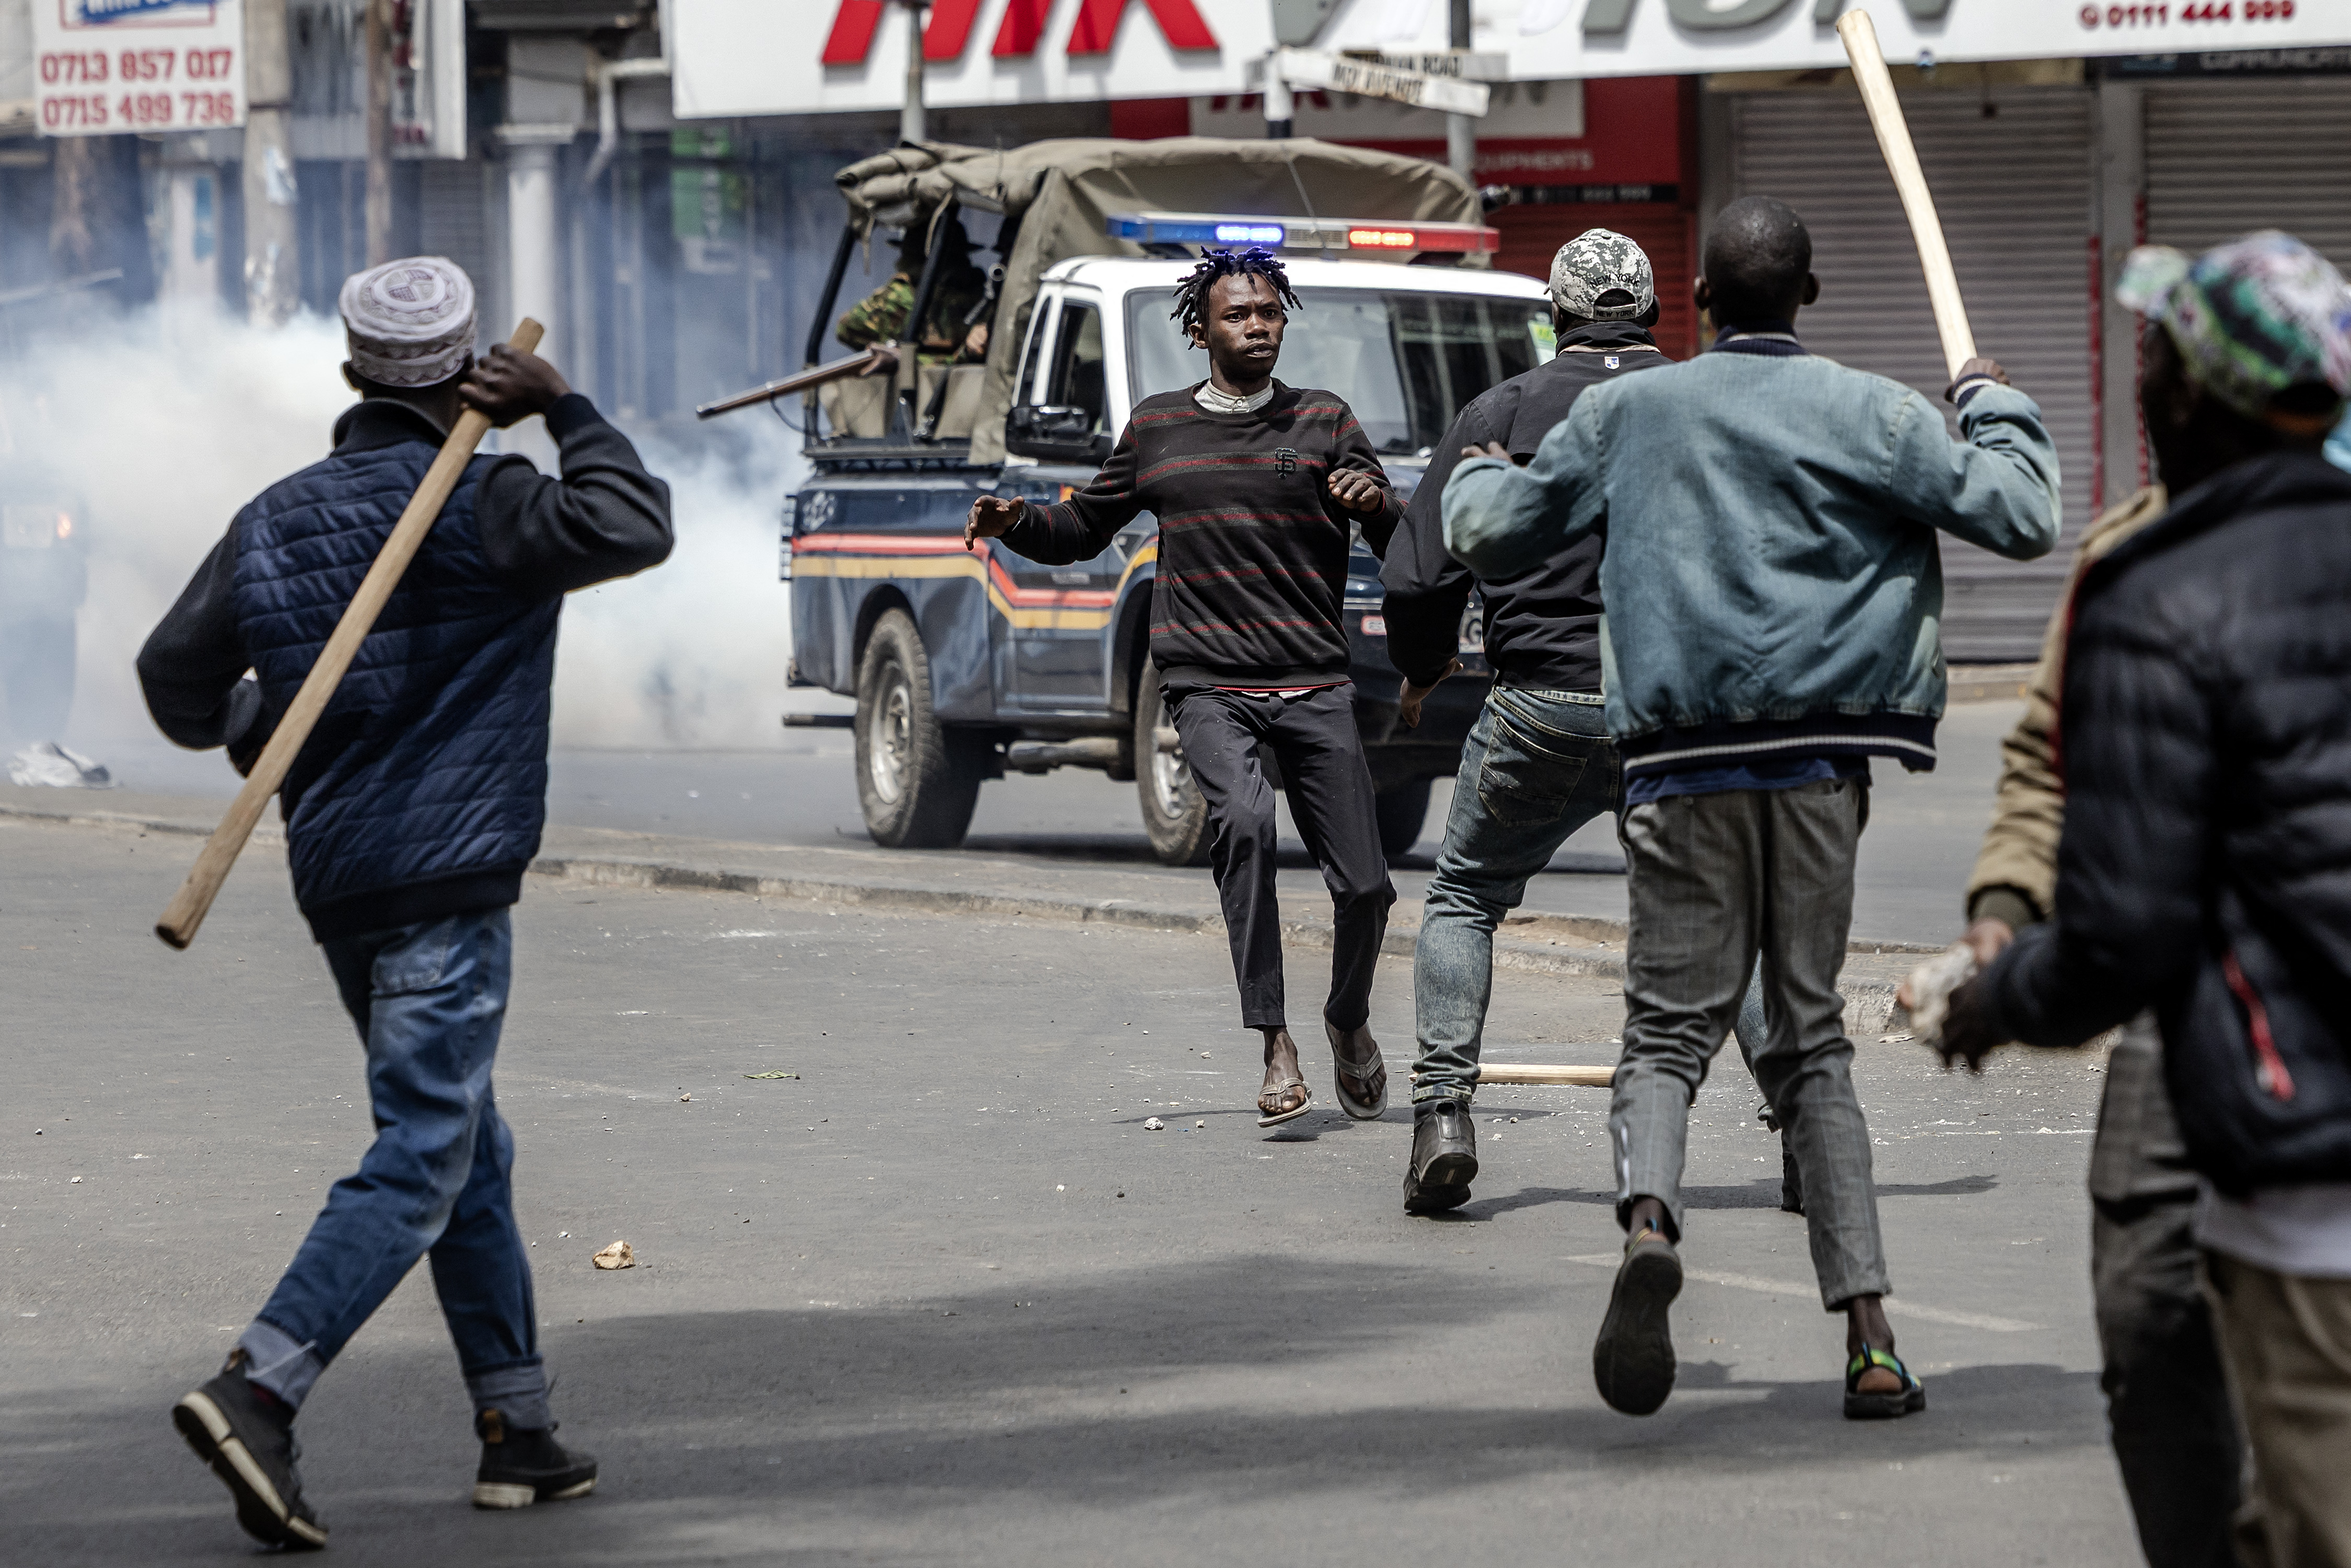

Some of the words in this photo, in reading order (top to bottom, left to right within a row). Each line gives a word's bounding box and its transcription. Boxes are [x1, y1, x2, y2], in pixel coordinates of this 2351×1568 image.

[2107, 5, 2167, 28] 0111
[41, 53, 108, 83] 0713
[121, 50, 174, 80] 857
[186, 49, 232, 78] 017
[43, 95, 107, 126] 0715
[118, 93, 173, 124] 499
[181, 92, 234, 123] 736
[1589, 274, 1611, 288] NEW
[1615, 274, 1640, 287] YORK
[1615, 308, 1635, 317] YORK
